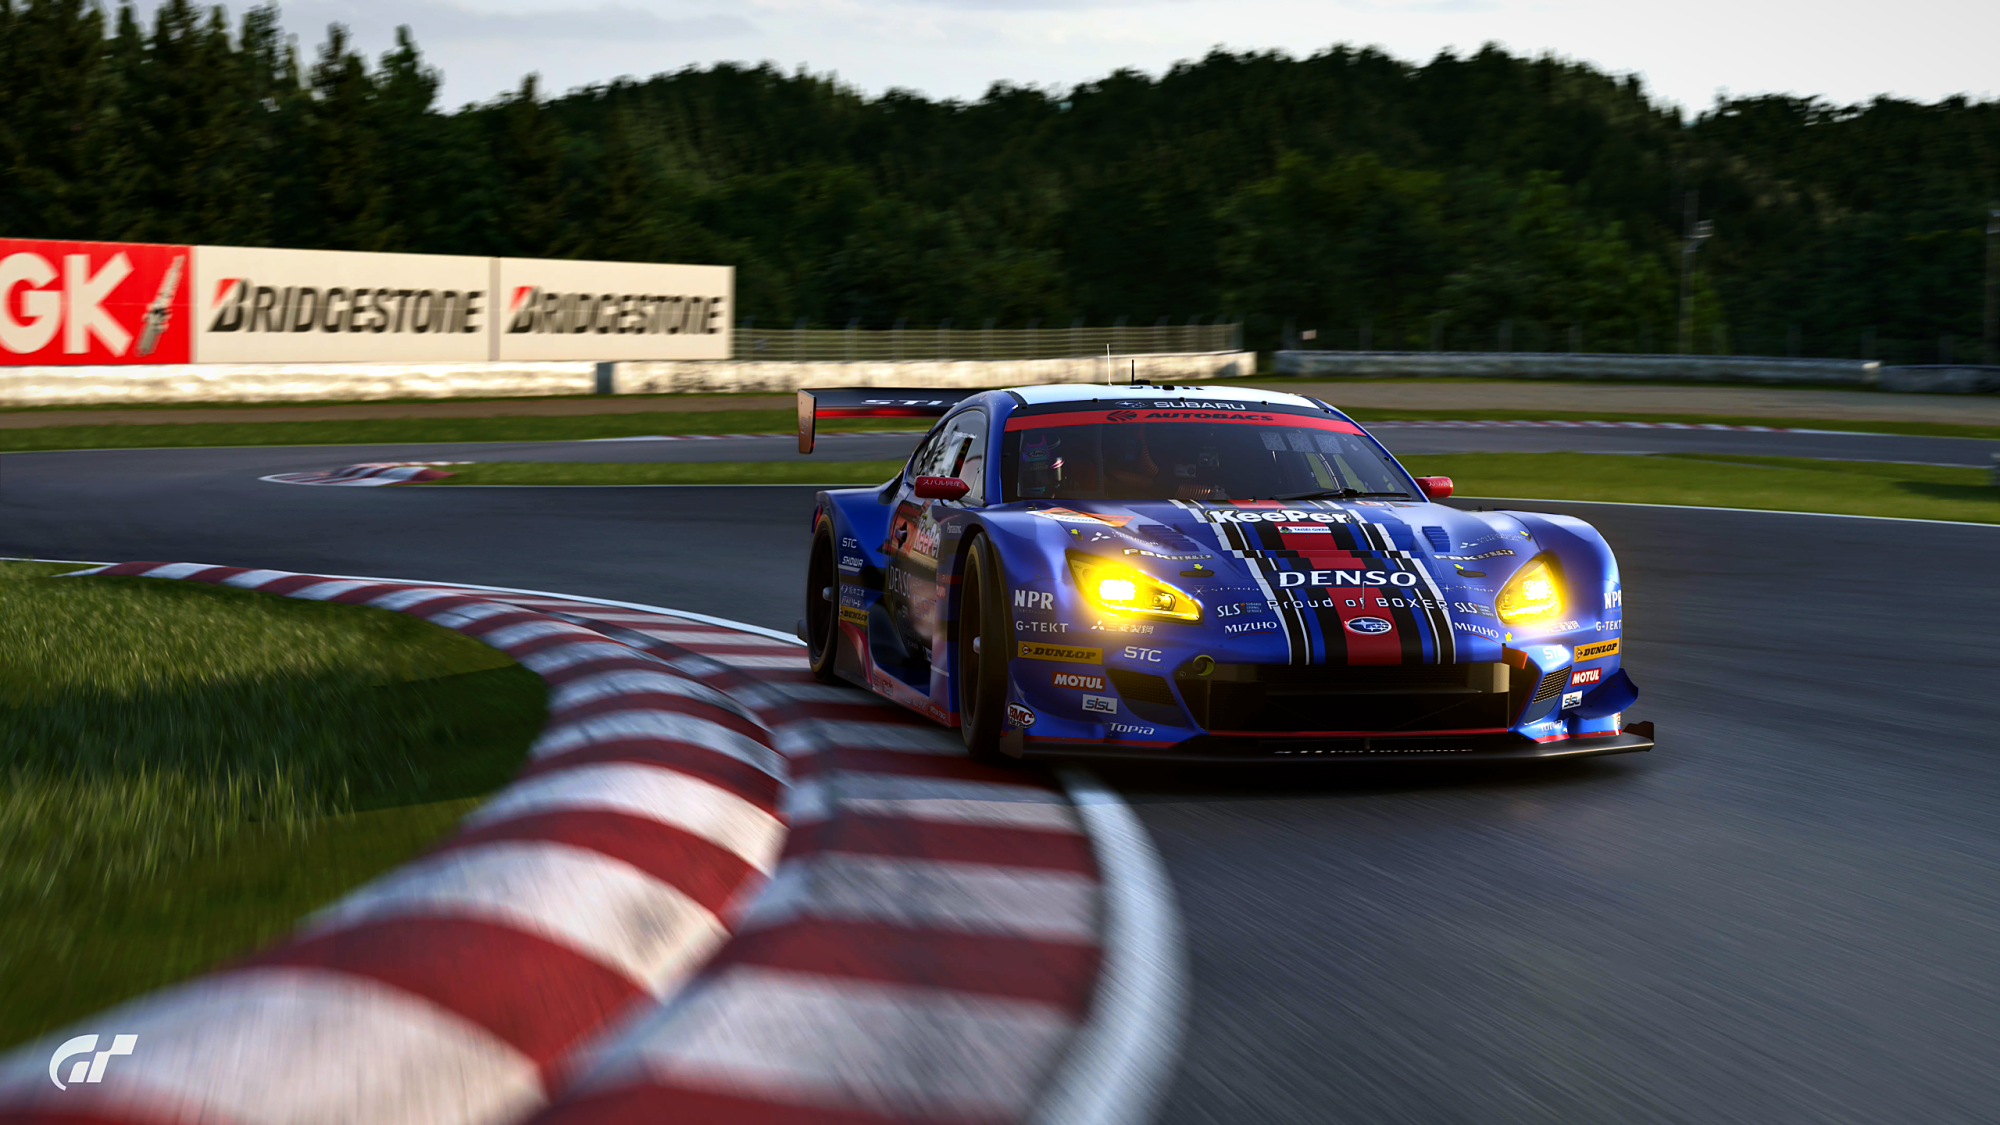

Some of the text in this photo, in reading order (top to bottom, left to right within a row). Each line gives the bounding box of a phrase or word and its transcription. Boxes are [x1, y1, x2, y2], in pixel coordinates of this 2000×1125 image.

[205, 278, 486, 333] BRIDGESTONE
[505, 286, 727, 334] BRIDGESTONE
[1153, 401, 1246, 411] SUBARU
[1144, 413, 1274, 421] AUTOBACS
[1209, 510, 1350, 524] KeePer
[842, 537, 858, 549] STC
[842, 556, 864, 568] SHOWA
[889, 566, 912, 599] DENSO
[1278, 570, 1417, 587] DENSO
[1014, 589, 1054, 610] NPR
[1267, 597, 1334, 610] Proud
[1375, 597, 1449, 610] BOXER
[1217, 603, 1241, 618] SLS
[1454, 602, 1477, 614] SLS
[1015, 620, 1069, 633] G-TEKT
[1224, 622, 1278, 635] MIZUHO
[1454, 622, 1499, 639] MIZUHO
[1033, 647, 1096, 660] DUNLOP
[1123, 646, 1162, 663] STC
[1583, 643, 1617, 657] DUNLOP
[1054, 674, 1103, 690] MOTUL
[1572, 670, 1600, 685] MOTUL
[1009, 706, 1033, 724] BMC
